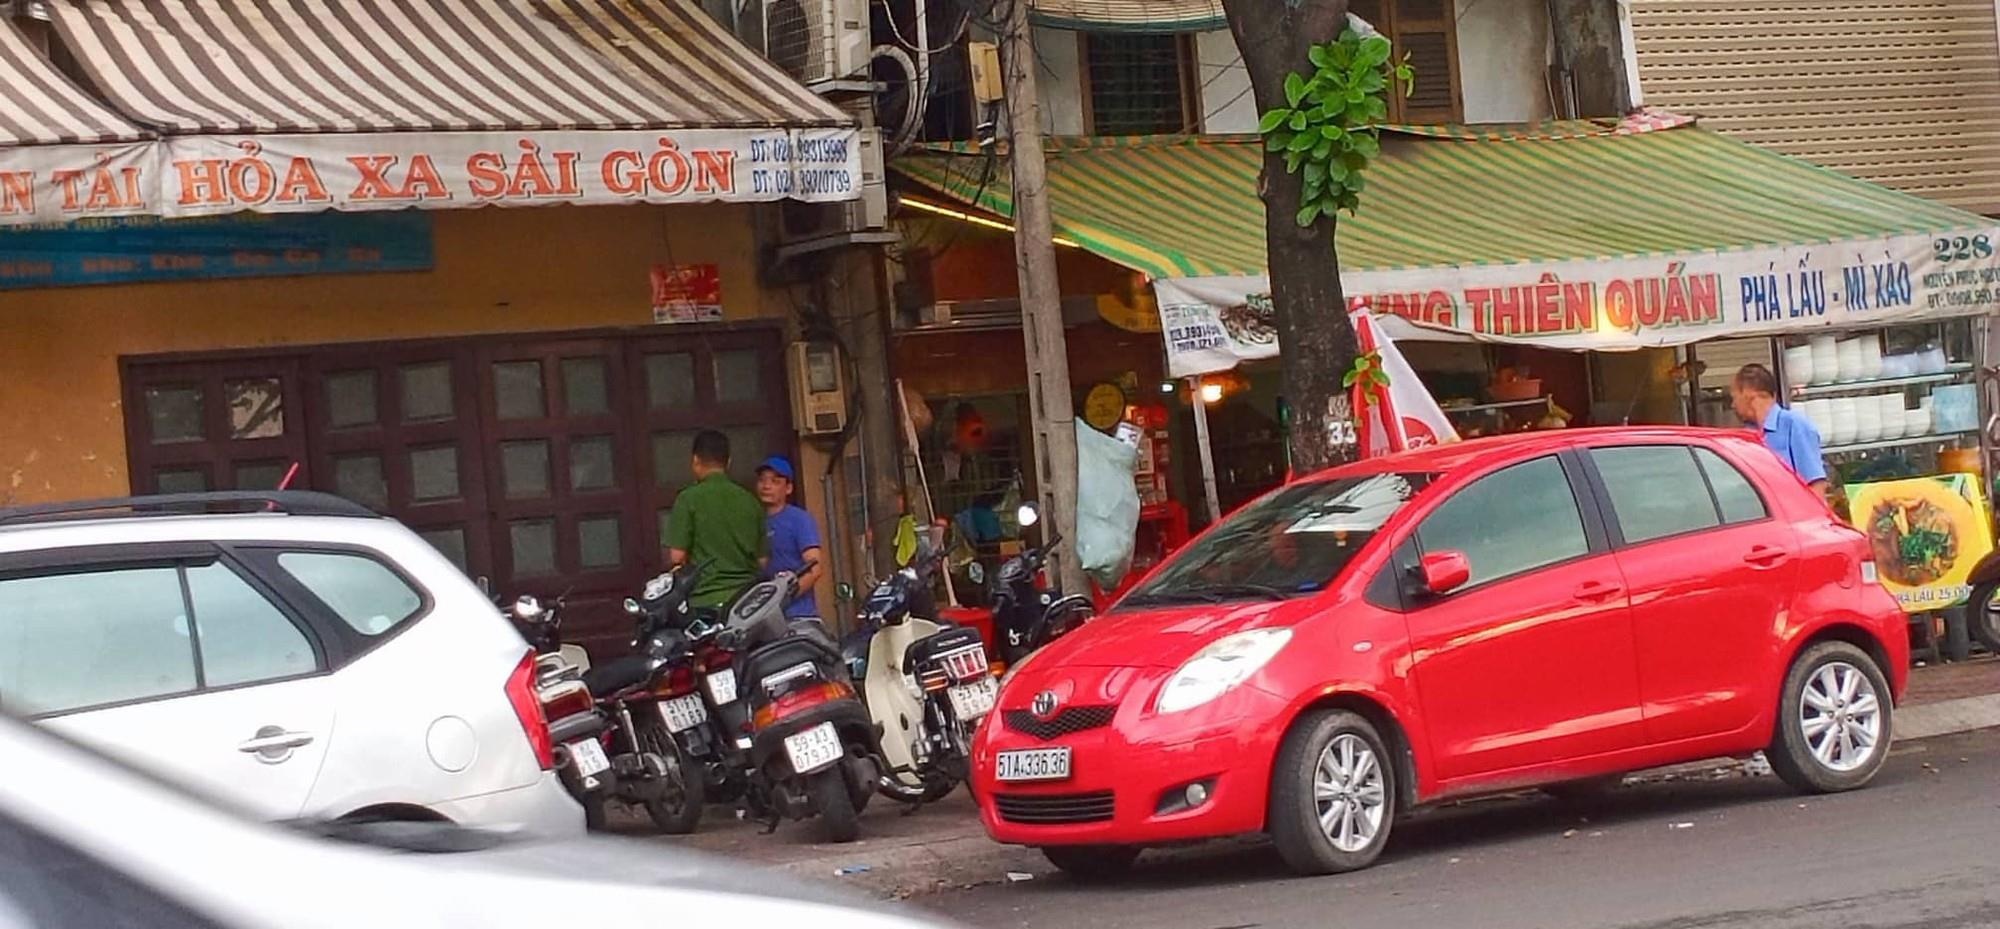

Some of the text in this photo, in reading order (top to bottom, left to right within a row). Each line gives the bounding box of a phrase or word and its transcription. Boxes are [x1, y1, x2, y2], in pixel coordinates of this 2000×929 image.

[51, 151, 146, 212] TẢI
[174, 141, 332, 205] HỎA
[346, 153, 452, 199] XA
[466, 138, 582, 198] SÀI
[601, 137, 738, 197] GÒN
[1933, 234, 1993, 262] 228
[1464, 272, 1598, 338] THIÊN
[1605, 261, 1724, 336] QUÁN
[1740, 261, 1781, 322] PHÁ
[1787, 252, 1826, 318] LẤU
[1843, 253, 1868, 311] MÌ
[1872, 250, 1912, 309] XÀO
